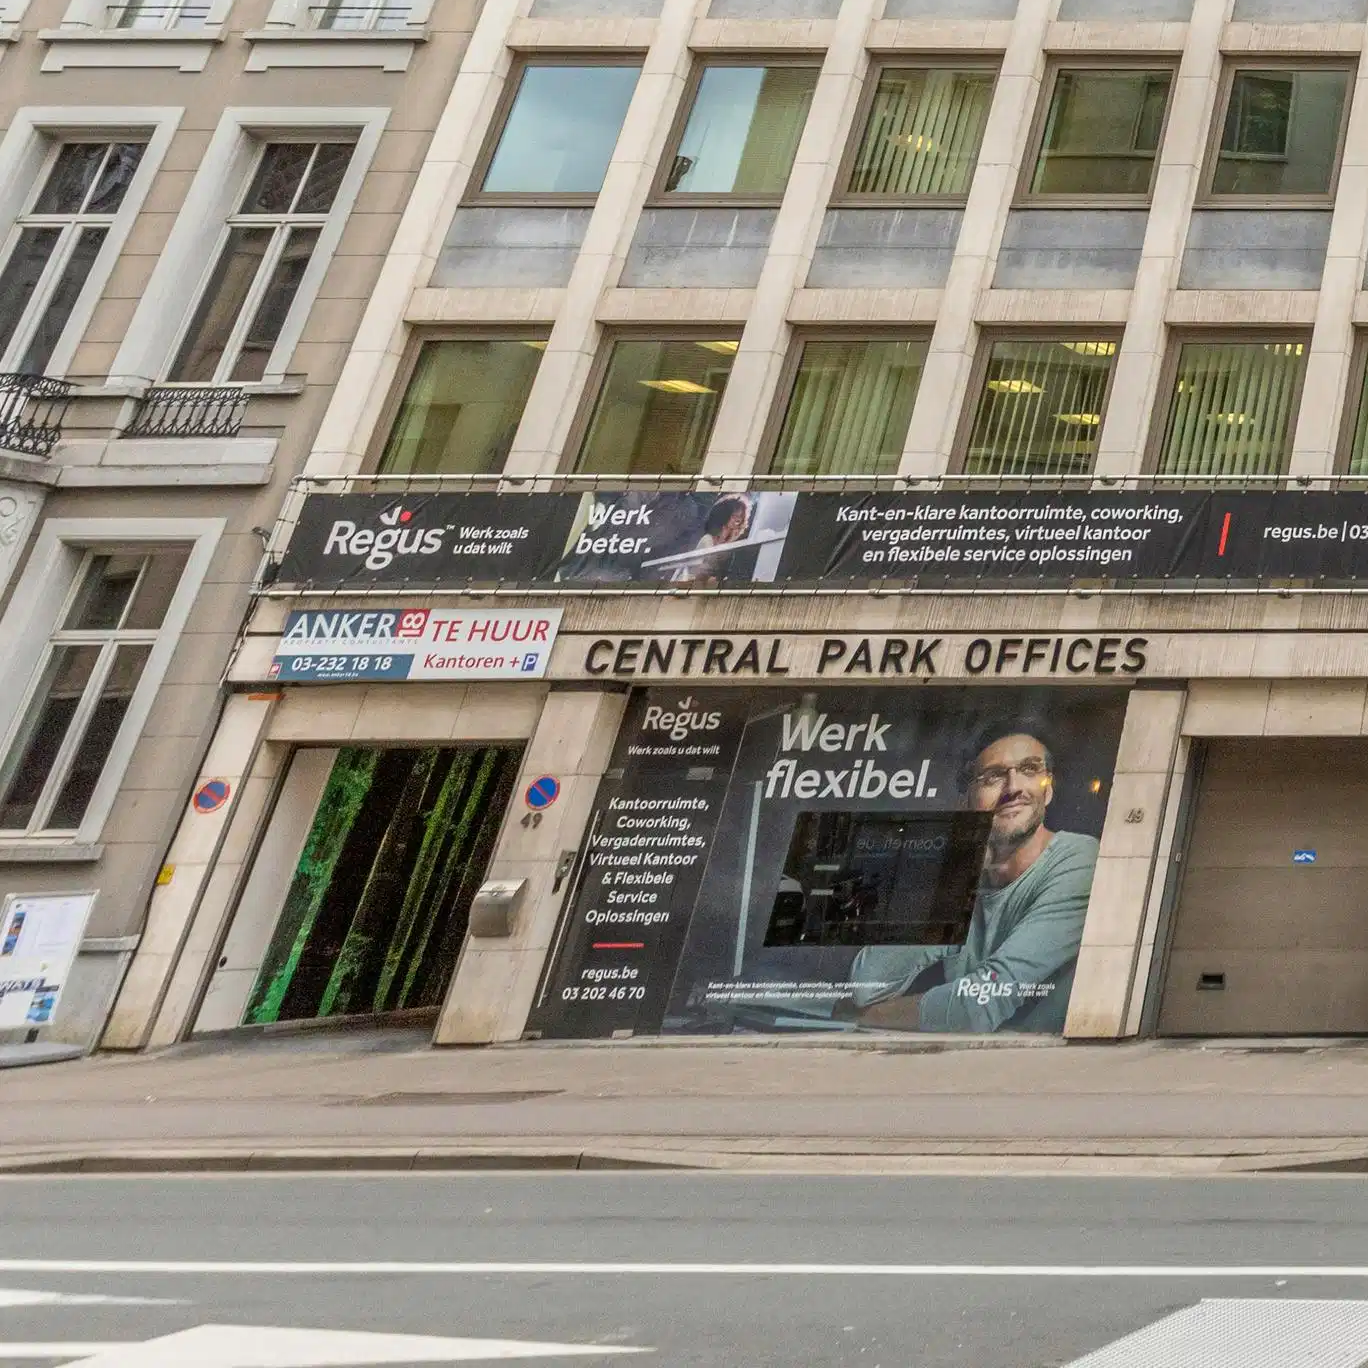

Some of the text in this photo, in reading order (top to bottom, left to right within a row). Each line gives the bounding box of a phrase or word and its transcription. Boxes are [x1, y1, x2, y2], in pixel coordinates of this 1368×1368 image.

[587, 504, 653, 526] Werk
[836, 504, 1183, 524] Kant-en-klare kantoorruimte, coworking,
[459, 526, 528, 539] Werk zoals
[862, 526, 1151, 544] vergaderruimtes, virtueel kantoor
[1263, 525, 1338, 542] regus.be
[453, 542, 512, 554] u dat wilt
[575, 533, 651, 554] beter.
[862, 546, 1132, 565] en flexibele service oplossingen
[282, 613, 396, 640] ANKER
[432, 619, 550, 642] TE HUUR
[291, 656, 392, 671] 03-232 18 18
[424, 653, 502, 669] Kantoren
[585, 637, 1148, 674] CENTRAL PARK OFFICES
[643, 700, 722, 740] Regus
[780, 713, 892, 752] Werk
[628, 745, 651, 755] Werk
[652, 745, 677, 755] zoals
[684, 745, 701, 754] dat
[702, 745, 720, 754] wilt
[764, 759, 938, 799] flexibel.
[608, 797, 710, 811] Kantoorruimte,
[520, 813, 543, 829] 49
[616, 816, 691, 830] Coworking,
[1125, 807, 1144, 823] 49
[591, 834, 706, 849] Vergaderruimtes,
[589, 852, 698, 866] Virtueel Kantoor
[602, 872, 673, 884] & Flexibele
[607, 891, 657, 903] Service
[585, 910, 670, 925] Oplossingen
[581, 966, 638, 982] regus.be
[562, 987, 645, 999] 03 202 46 70
[957, 972, 1013, 1005] Regus
